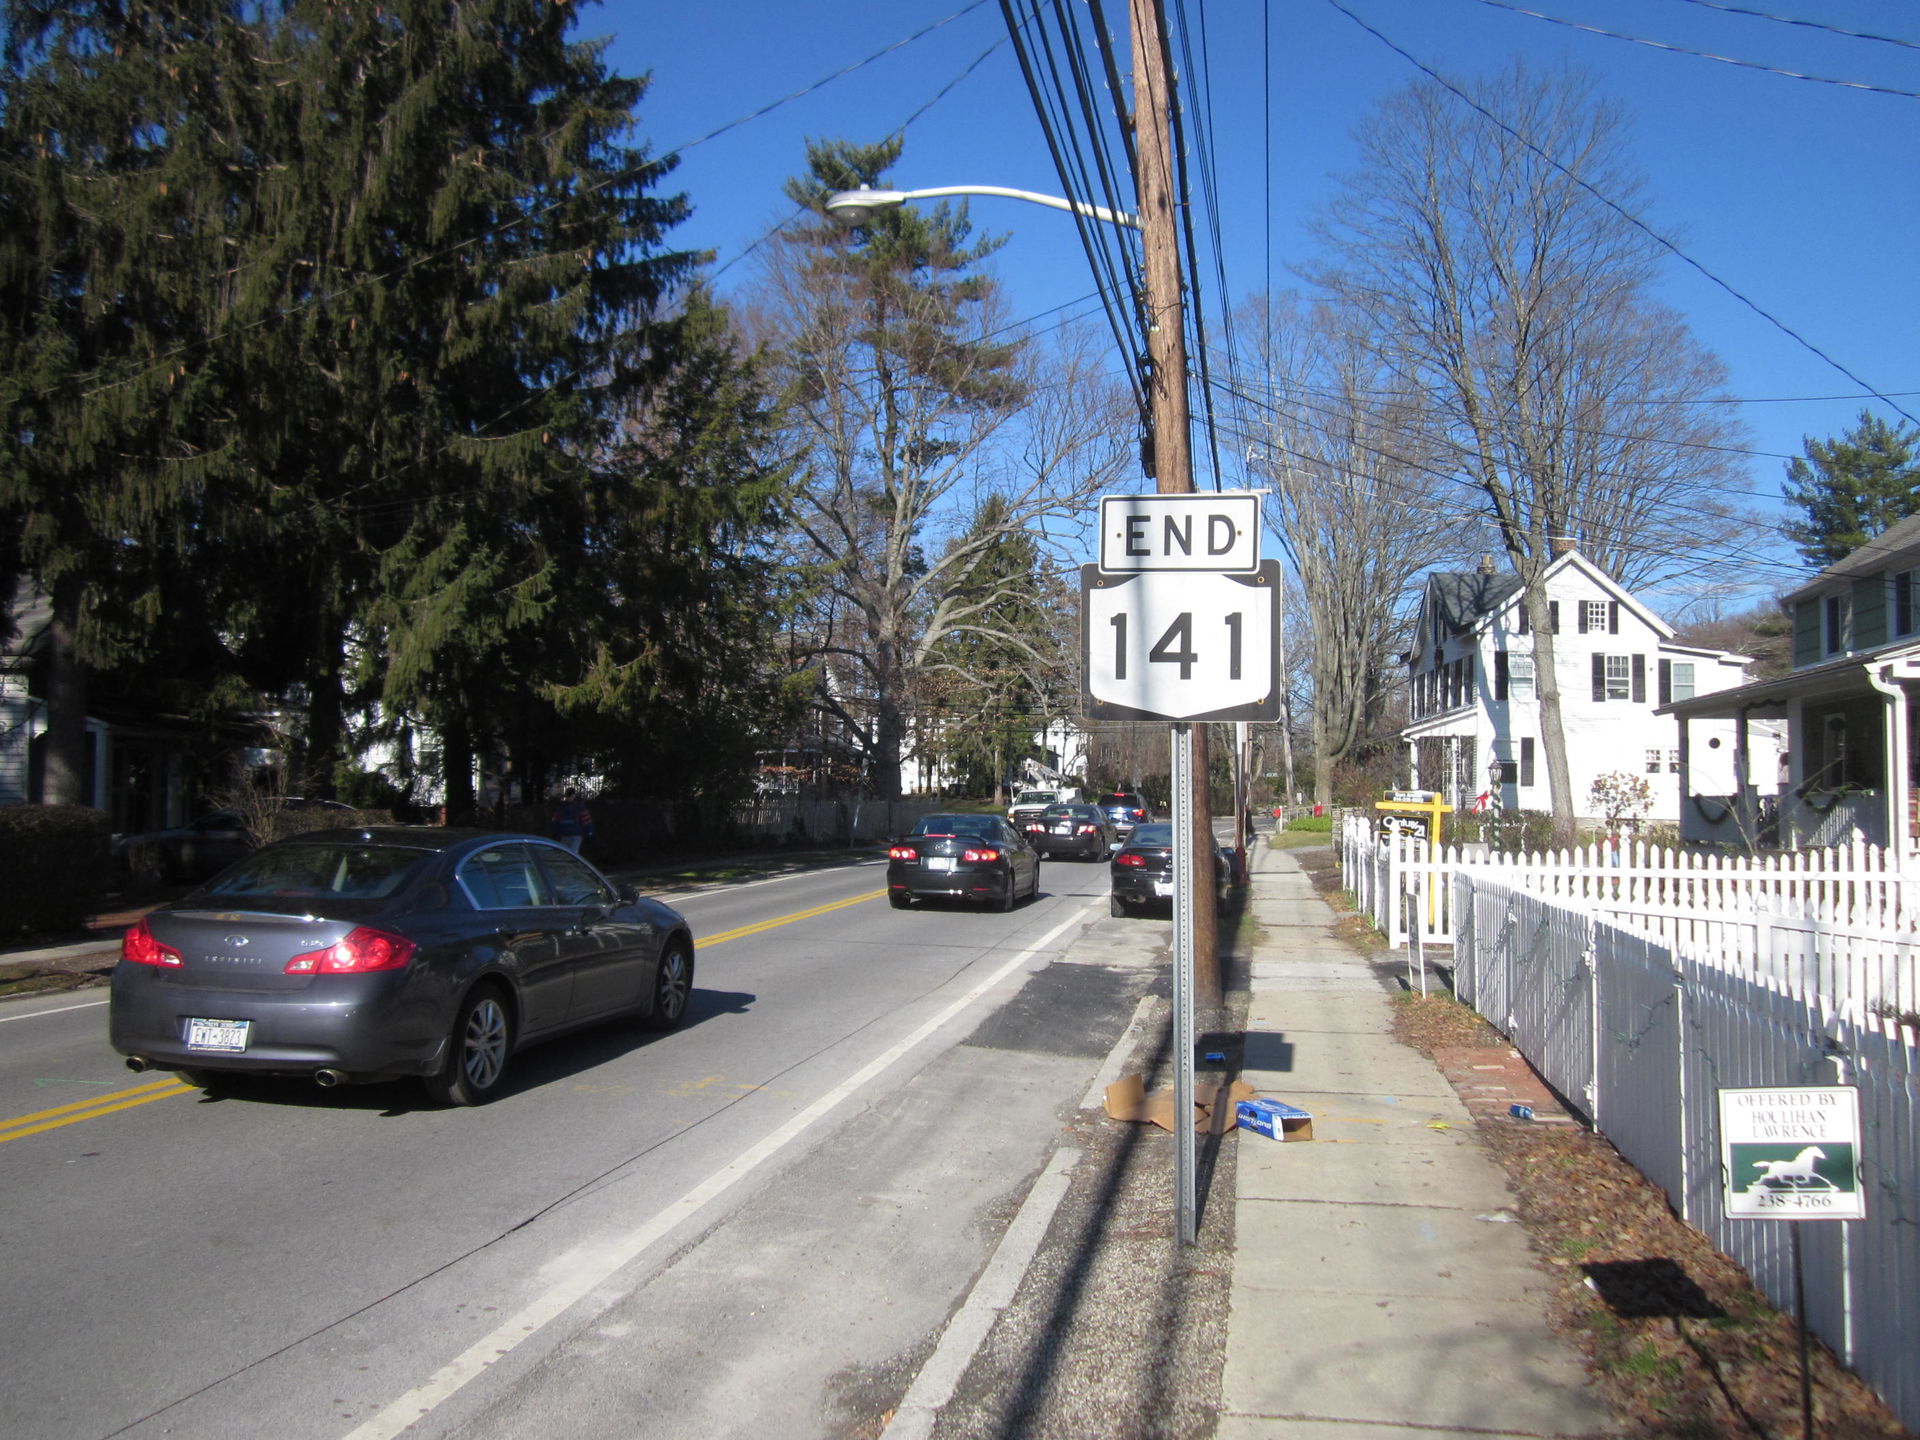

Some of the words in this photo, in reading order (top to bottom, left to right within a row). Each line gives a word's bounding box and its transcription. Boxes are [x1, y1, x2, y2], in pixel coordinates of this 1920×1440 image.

[1126, 514, 1236, 556] END
[1110, 612, 1242, 680] 141
[1383, 816, 1418, 829] Cntury
[1737, 1094, 1810, 1106] OFFERED
[1819, 1094, 1838, 1106] BY
[1752, 1110, 1827, 1124] HOULIHAN
[1752, 1124, 1827, 1138] LAWRENCE
[1757, 1194, 1832, 1208] 238-4766
